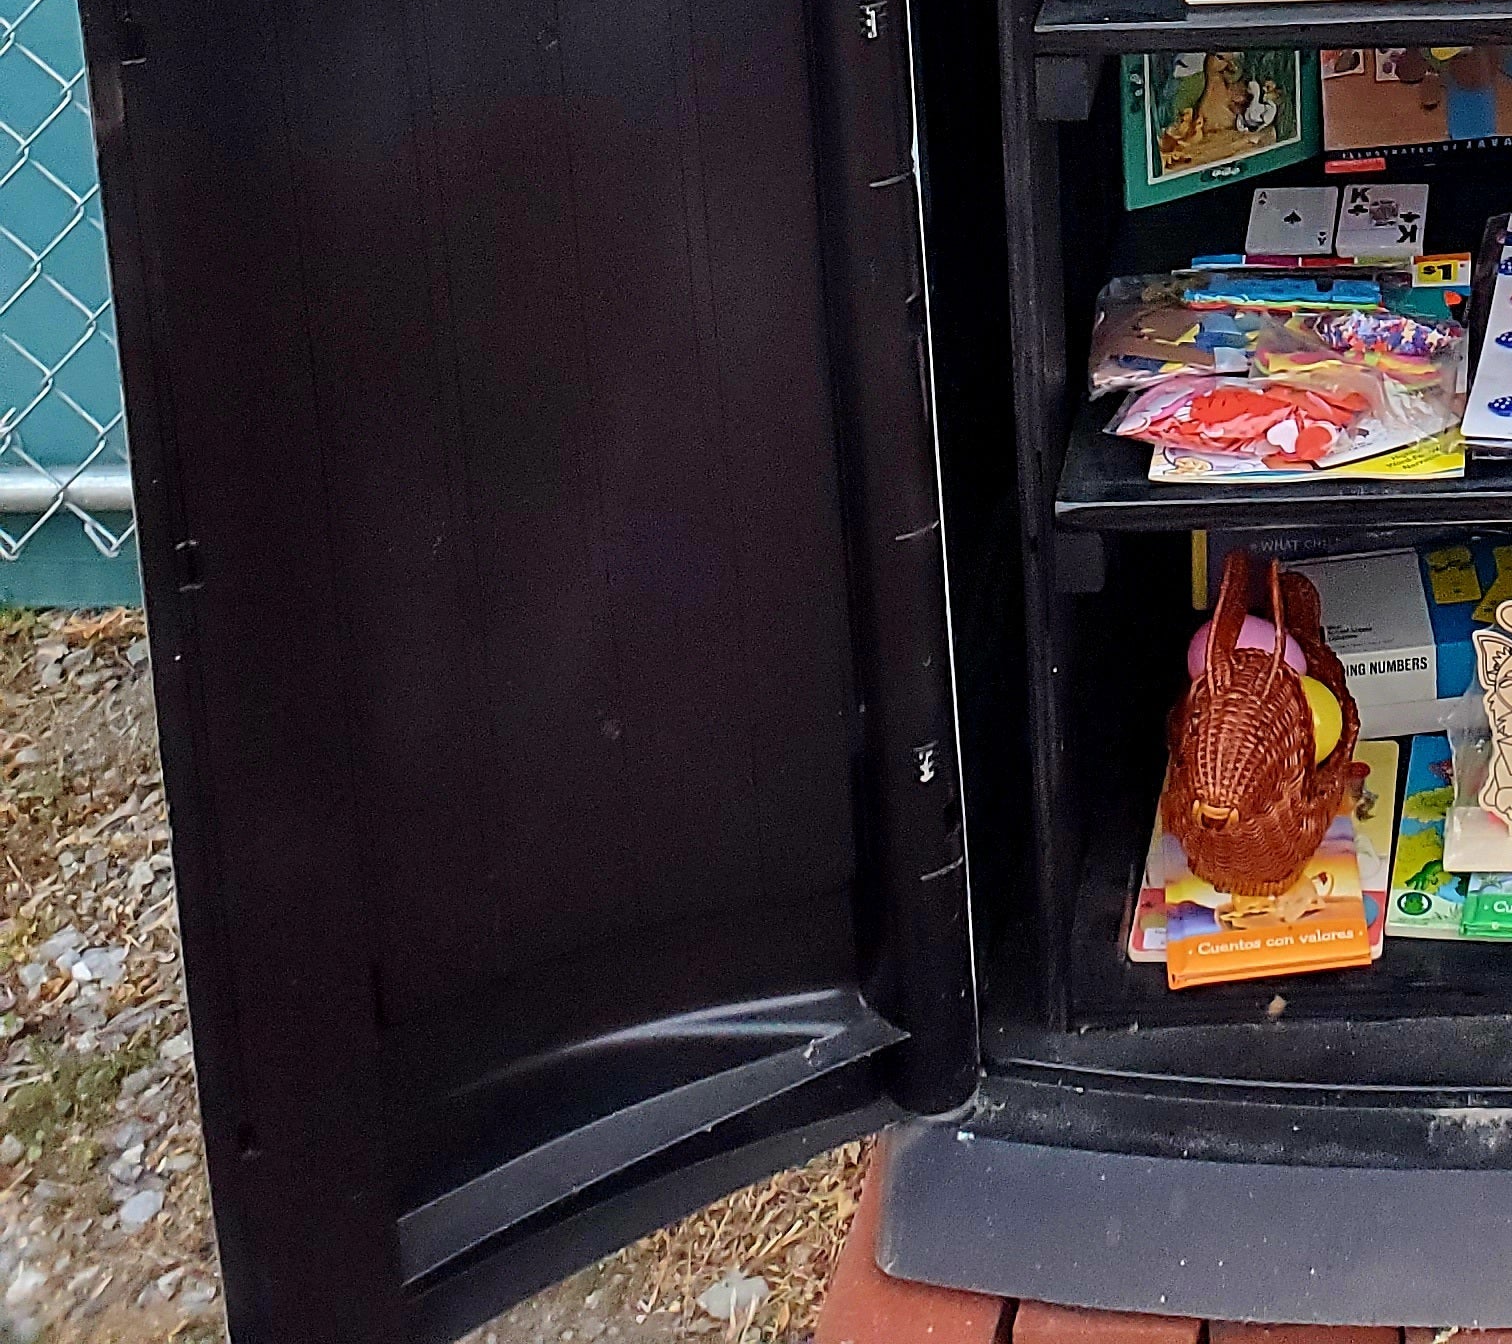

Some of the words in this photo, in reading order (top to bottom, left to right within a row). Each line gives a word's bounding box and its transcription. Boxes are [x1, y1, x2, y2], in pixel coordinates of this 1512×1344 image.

[1424, 263, 1452, 281] $1
[1370, 657, 1428, 674] NUMBERS
[1198, 937, 1260, 955] Cuentos
[1265, 935, 1294, 947] con
[1299, 928, 1354, 945] valores
